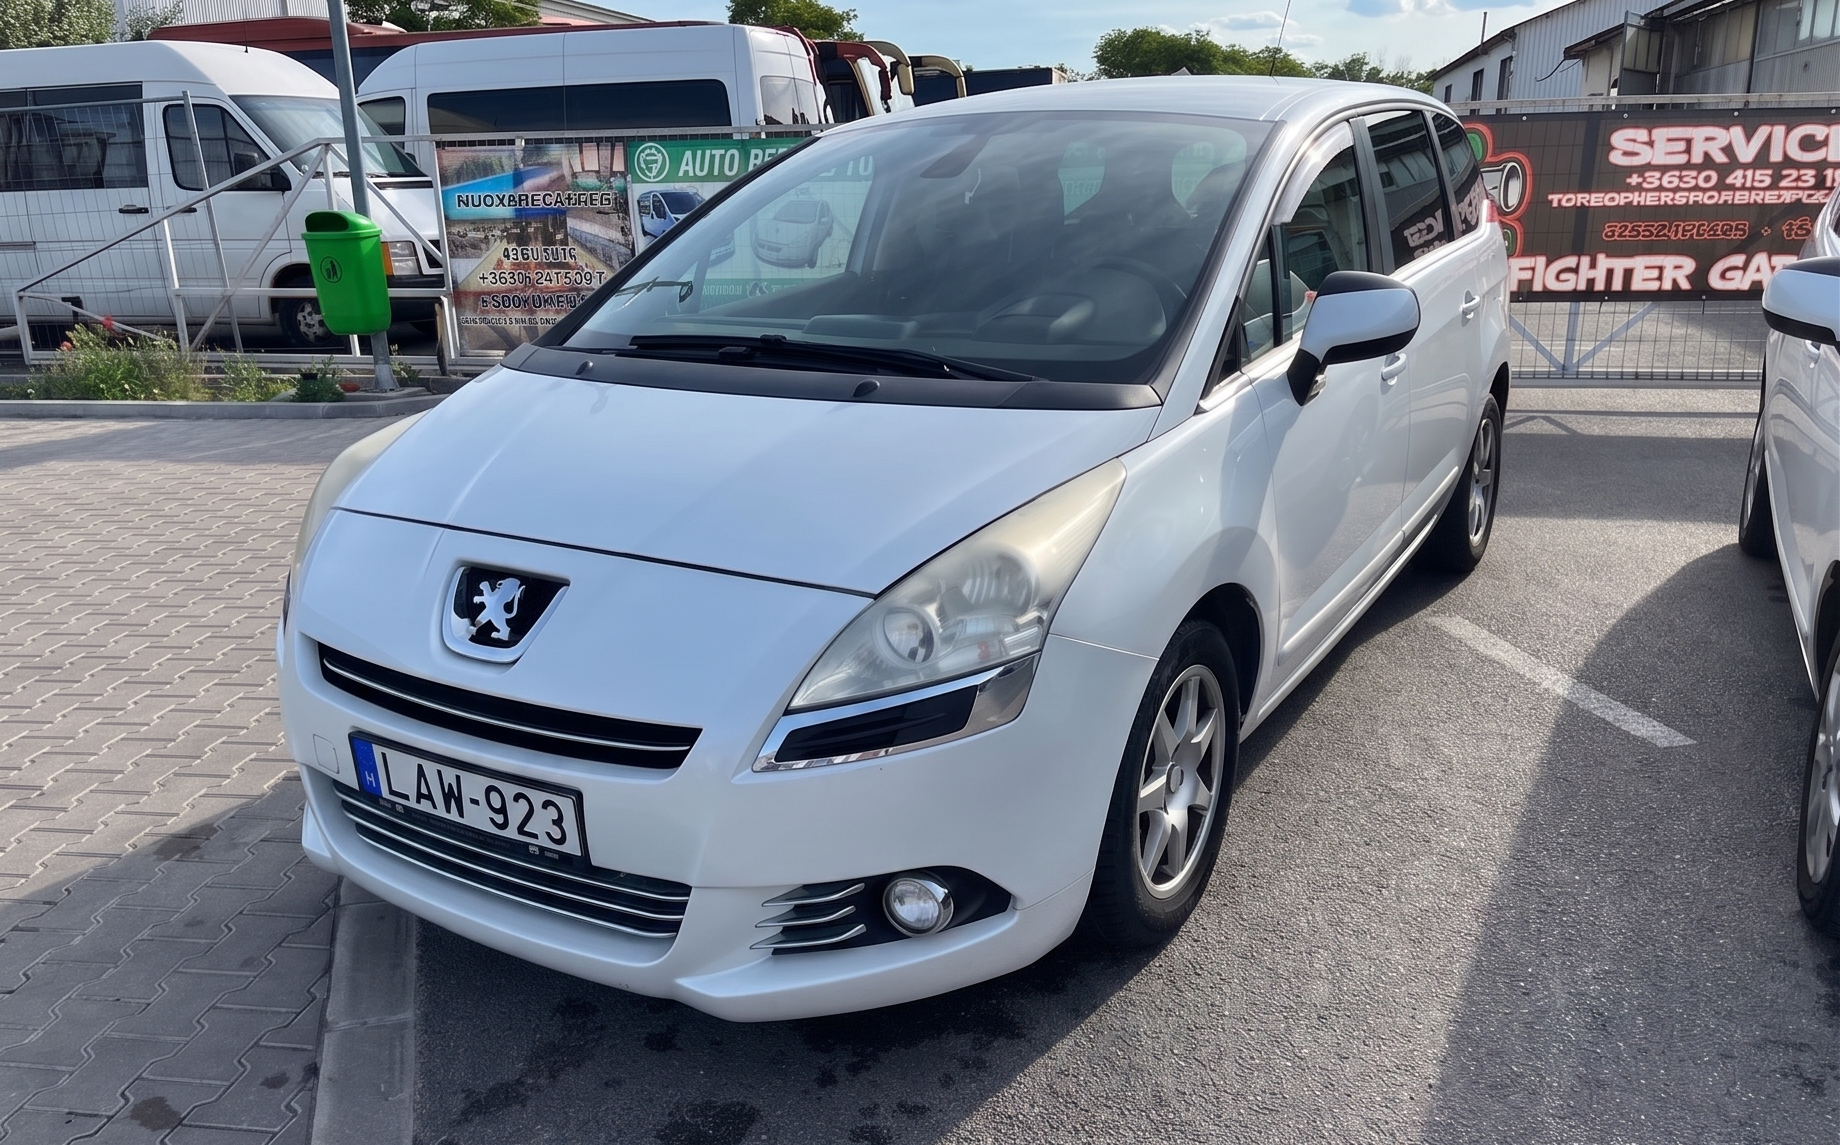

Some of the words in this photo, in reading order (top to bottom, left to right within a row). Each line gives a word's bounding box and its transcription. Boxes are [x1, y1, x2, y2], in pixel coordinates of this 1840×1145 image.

[678, 149, 739, 176] AUTO
[1626, 170, 1718, 189] +3630
[1725, 169, 1772, 188] 415
[1779, 168, 1816, 188] 23
[1508, 252, 1697, 292] FIGHTER
[365, 770, 376, 788] H
[381, 751, 568, 846] LAW-923
